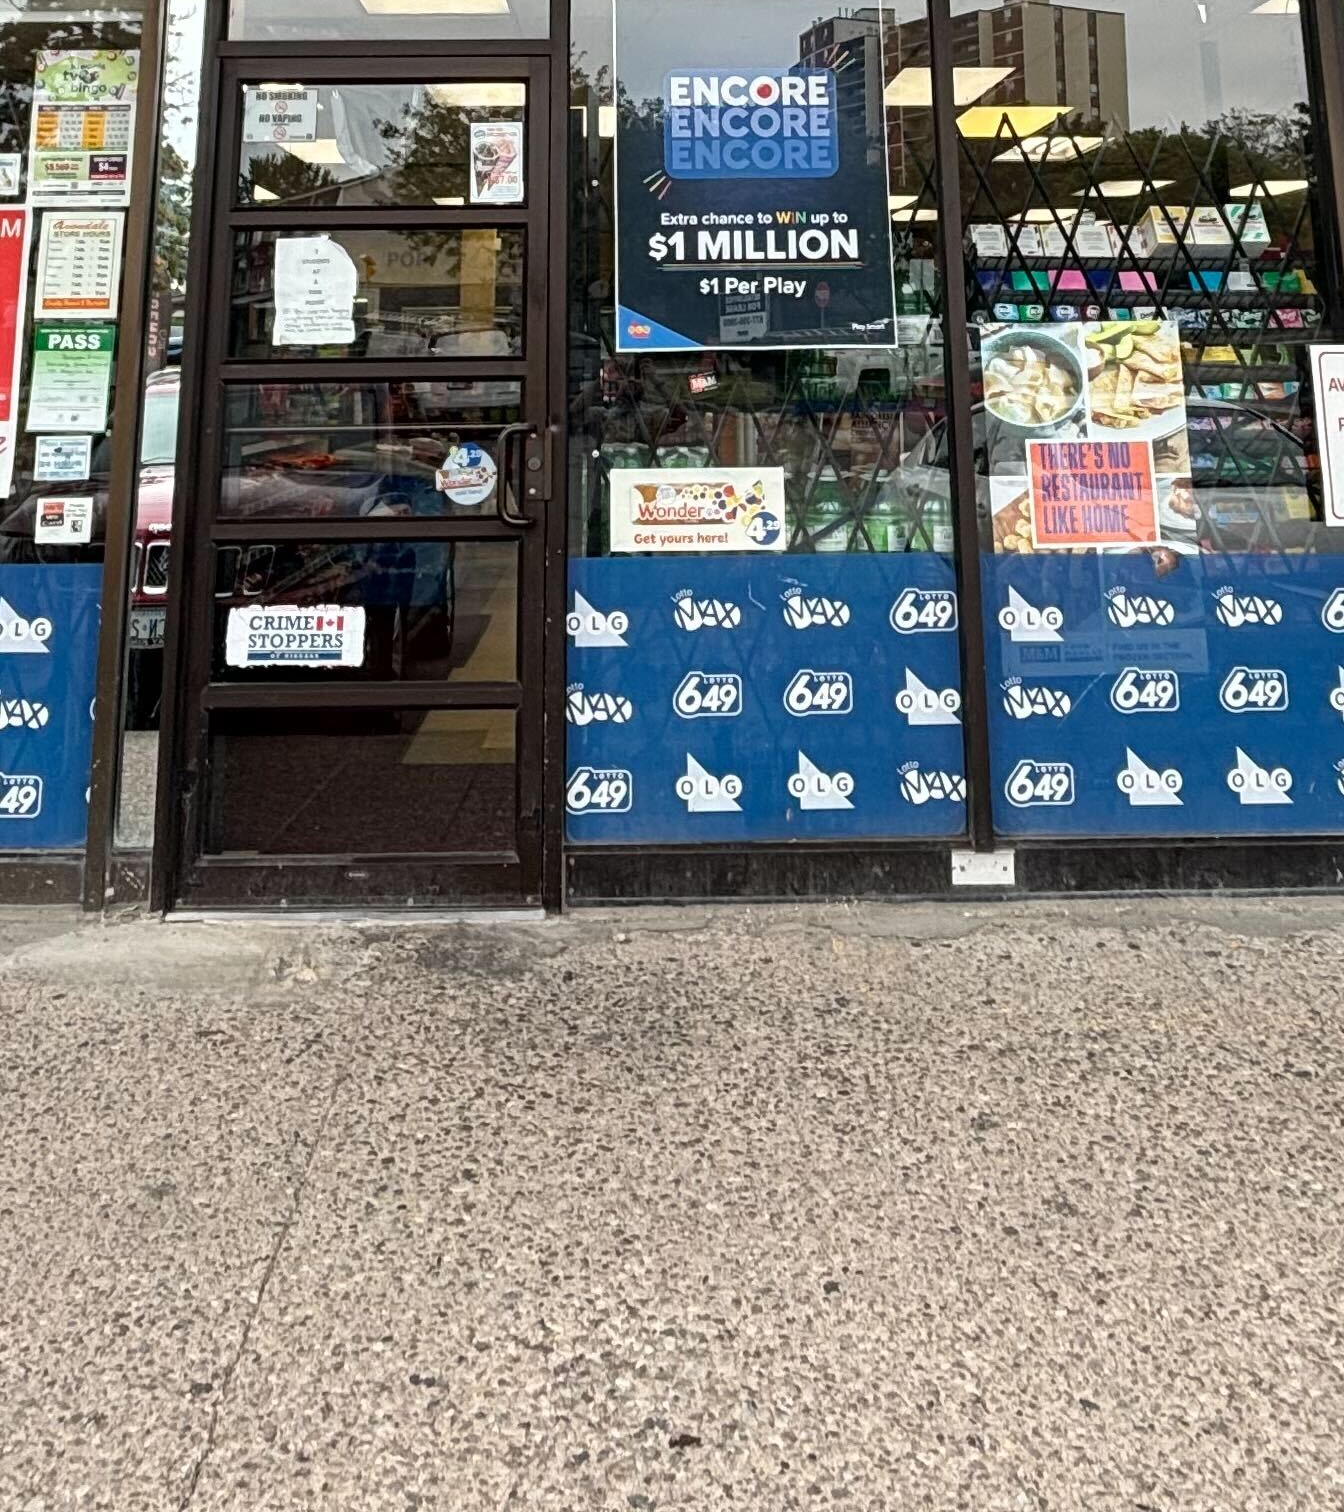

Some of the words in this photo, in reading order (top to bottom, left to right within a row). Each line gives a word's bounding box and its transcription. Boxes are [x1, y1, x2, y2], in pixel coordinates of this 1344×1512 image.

[670, 75, 830, 106] ENCORE
[670, 107, 831, 138] ENCORE
[671, 139, 833, 170] ENCORE
[661, 212, 698, 226] Extra
[702, 211, 754, 226] chance
[757, 212, 773, 226] to
[776, 212, 807, 225] WIN
[810, 214, 829, 228] up
[832, 211, 848, 225] to
[648, 230, 685, 262] $1
[697, 229, 860, 260] MILLION
[699, 279, 720, 295] $1
[724, 278, 758, 294] Per
[763, 277, 807, 298] Play
[48, 334, 101, 349] PASS
[1038, 442, 1105, 470] THERE'S
[1108, 441, 1131, 469] NO
[1041, 472, 1144, 502] RESTAURANT
[638, 503, 706, 520] Wonder
[1044, 505, 1080, 534] LIKE
[1081, 504, 1130, 534] HOME
[634, 533, 657, 545] Get
[659, 534, 695, 546] yours
[697, 532, 729, 545] here!
[249, 615, 314, 630] CRIME
[675, 595, 741, 630] MAX
[1108, 595, 1175, 627] MAX
[248, 633, 344, 648] STOPPERS
[679, 675, 737, 712] 649
[1116, 670, 1174, 707] 649
